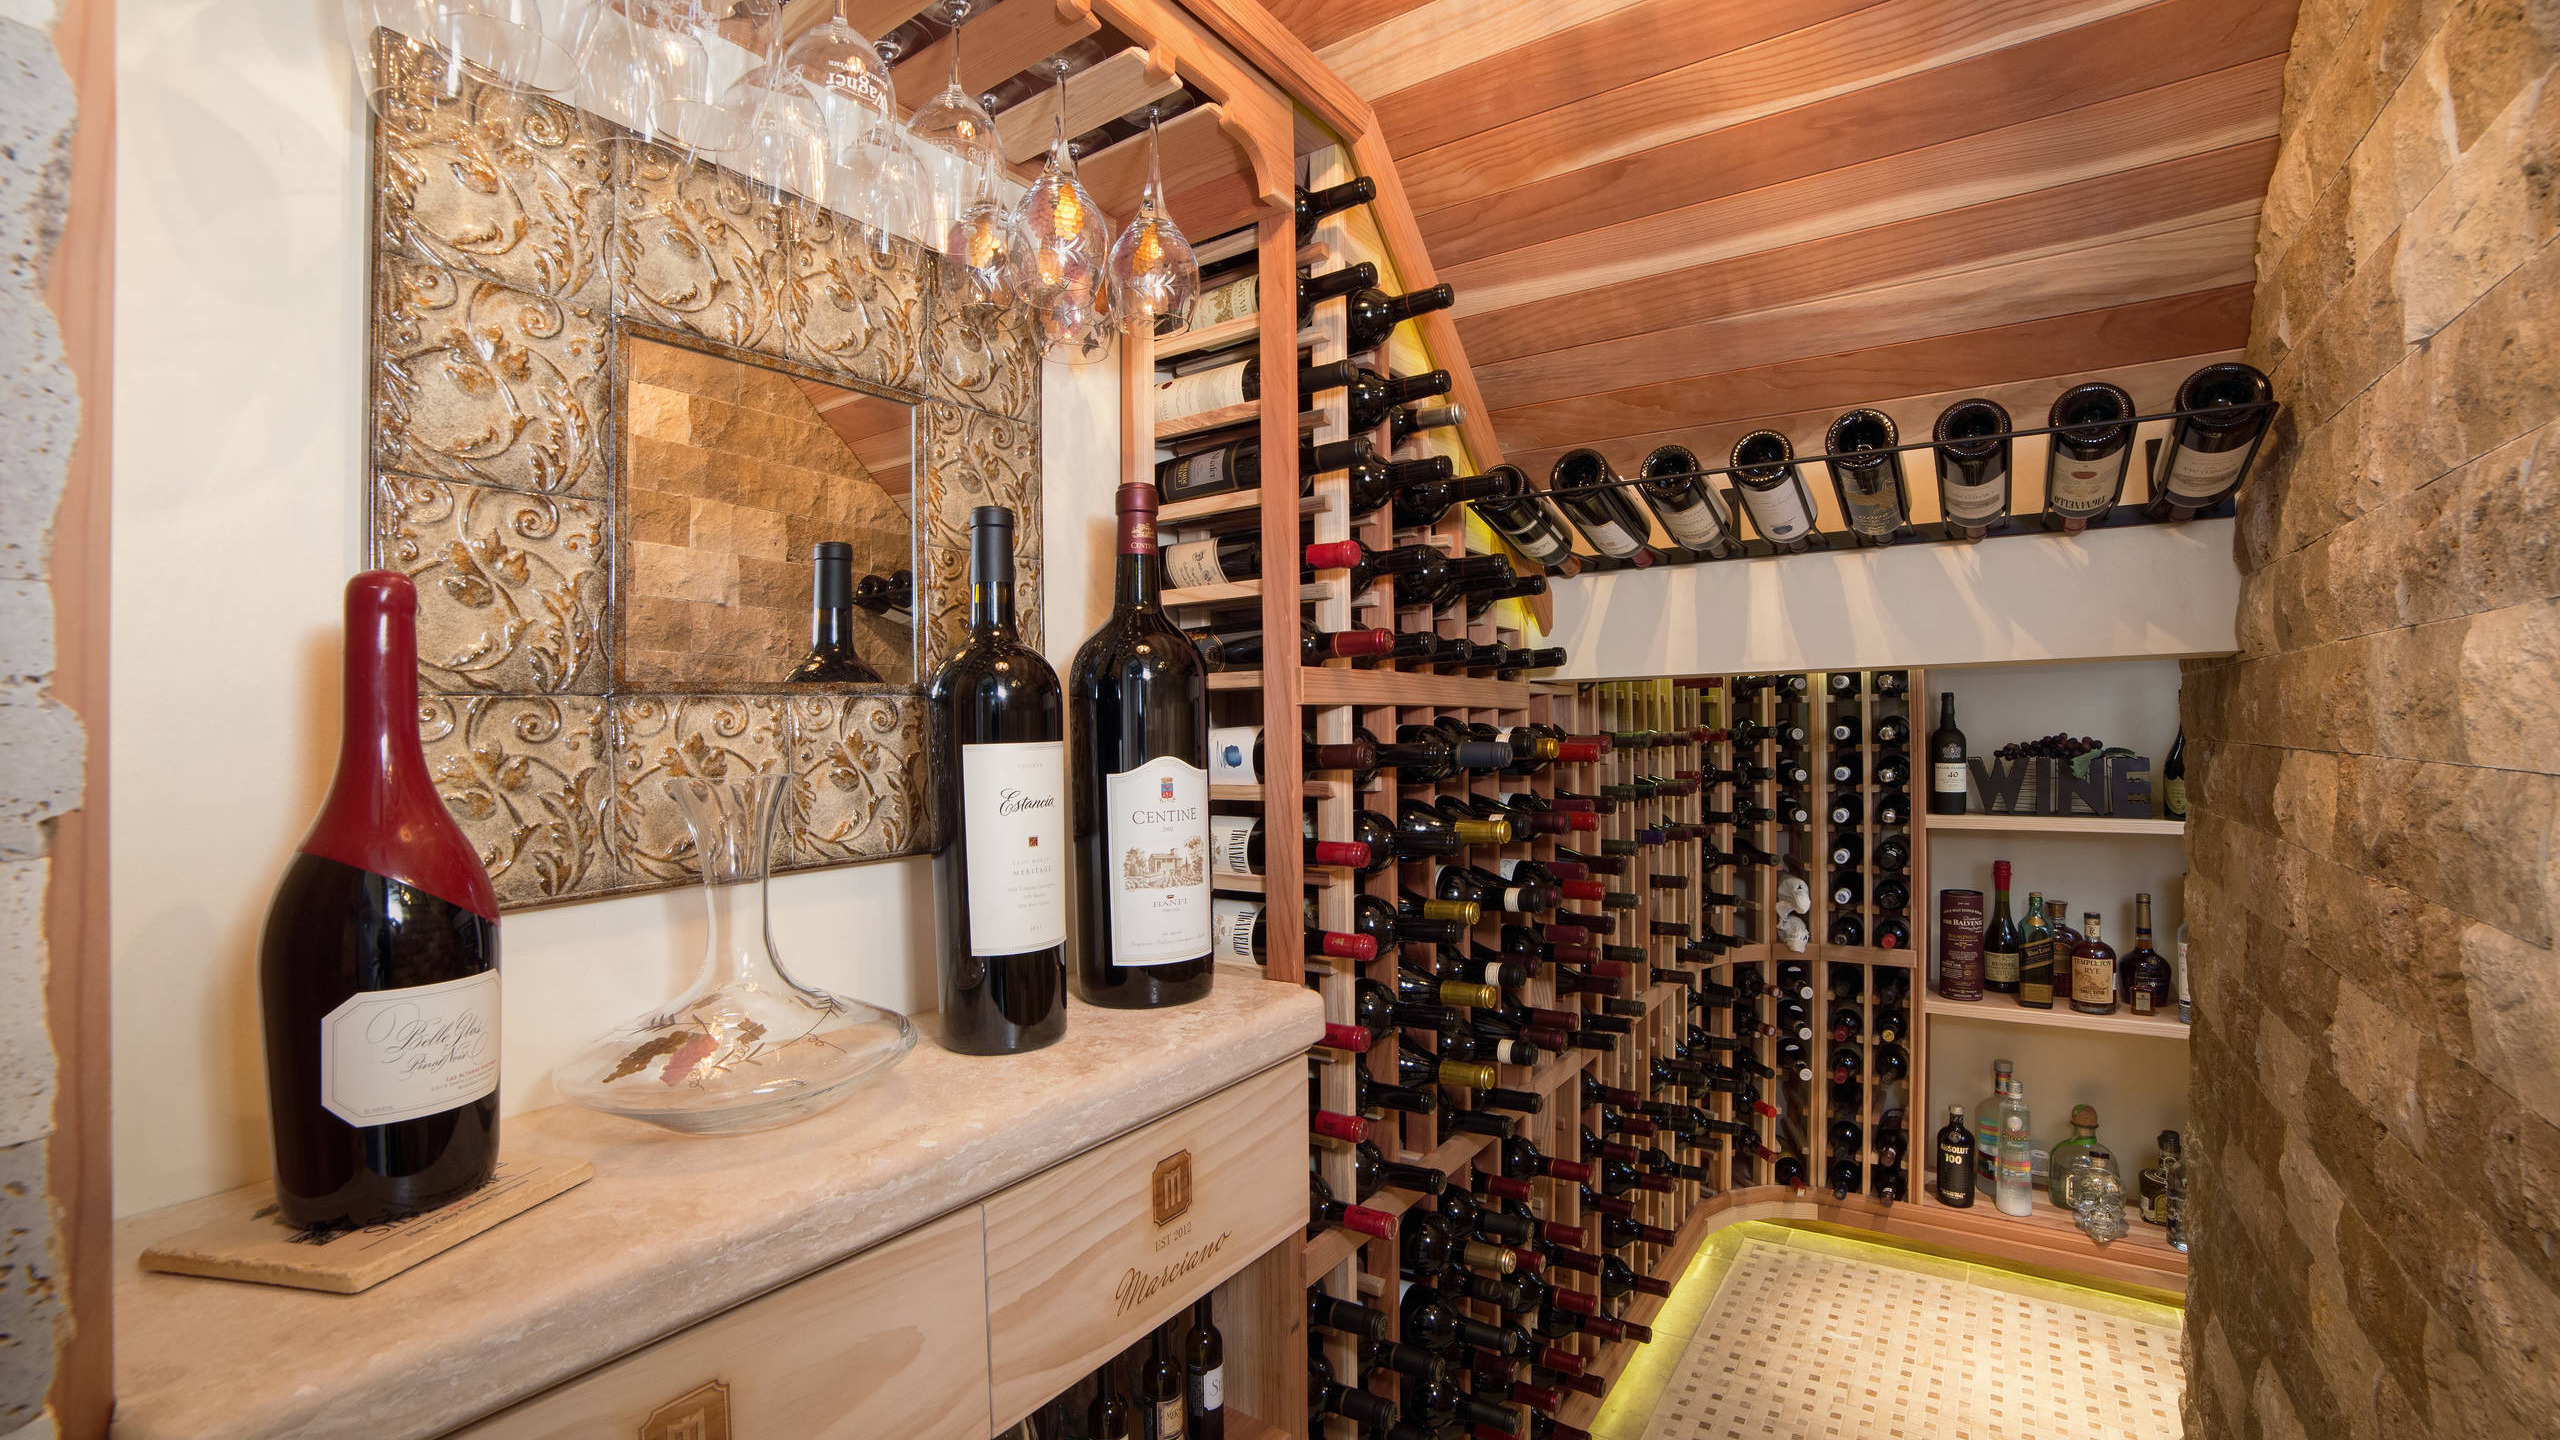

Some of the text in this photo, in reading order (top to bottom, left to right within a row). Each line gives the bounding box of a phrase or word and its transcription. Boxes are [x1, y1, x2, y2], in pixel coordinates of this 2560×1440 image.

[825, 72, 888, 115] Wagner
[999, 788, 1056, 817] Estancia
[1967, 756, 2150, 819] WINE
[1132, 807, 1198, 825] CENTINE
[1229, 829, 1249, 874] TIGNANELLO
[1232, 911, 1256, 956] TIGNANELLO
[2084, 967, 2101, 975] RYE
[450, 1006, 482, 1048] Glos
[1944, 1154, 1962, 1165] 100
[1155, 1222, 1192, 1252] EST 2012
[1115, 1229, 1233, 1318] Marciano
